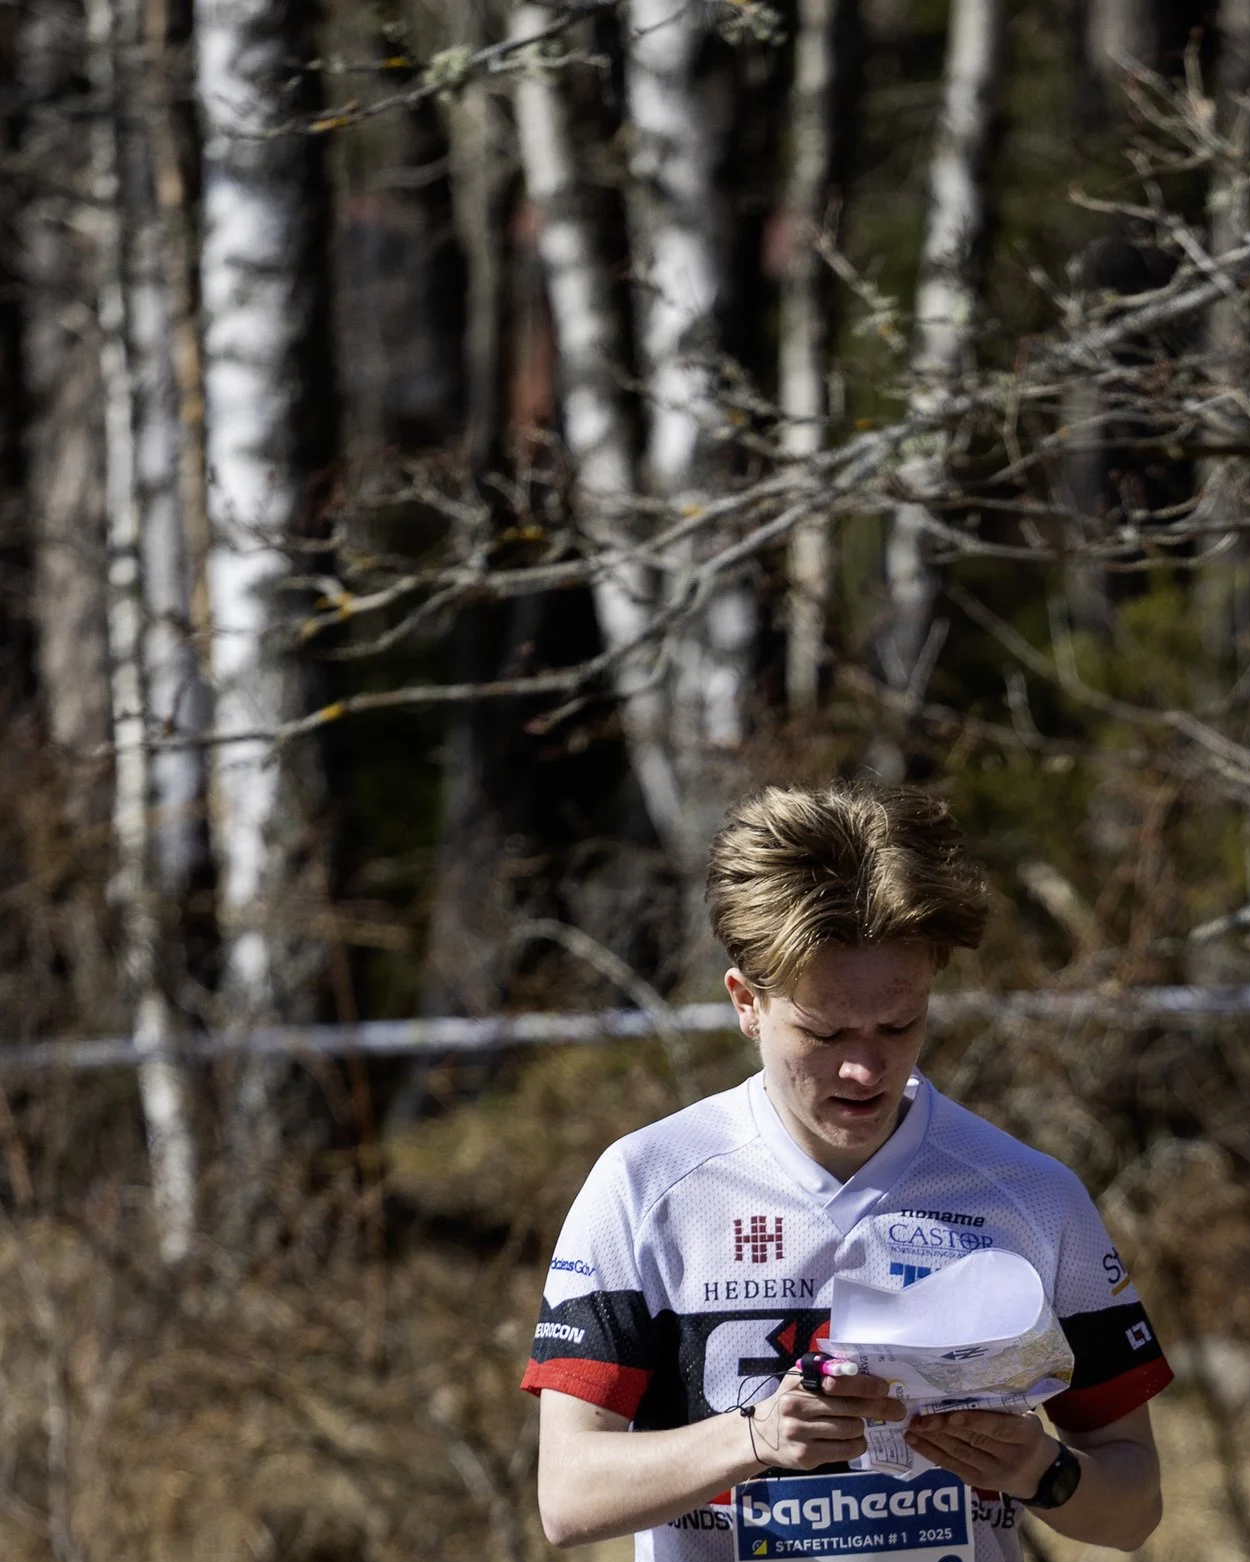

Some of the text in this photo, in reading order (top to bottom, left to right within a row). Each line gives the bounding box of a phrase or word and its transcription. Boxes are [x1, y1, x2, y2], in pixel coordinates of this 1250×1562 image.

[901, 1208, 985, 1227] noname
[888, 1223, 993, 1251] CASTOR
[704, 1279, 815, 1301] HEDERN
[743, 1486, 959, 1530] bagheera
[775, 1534, 884, 1553] STAFETTLIGAN
[918, 1528, 953, 1542] 2025
